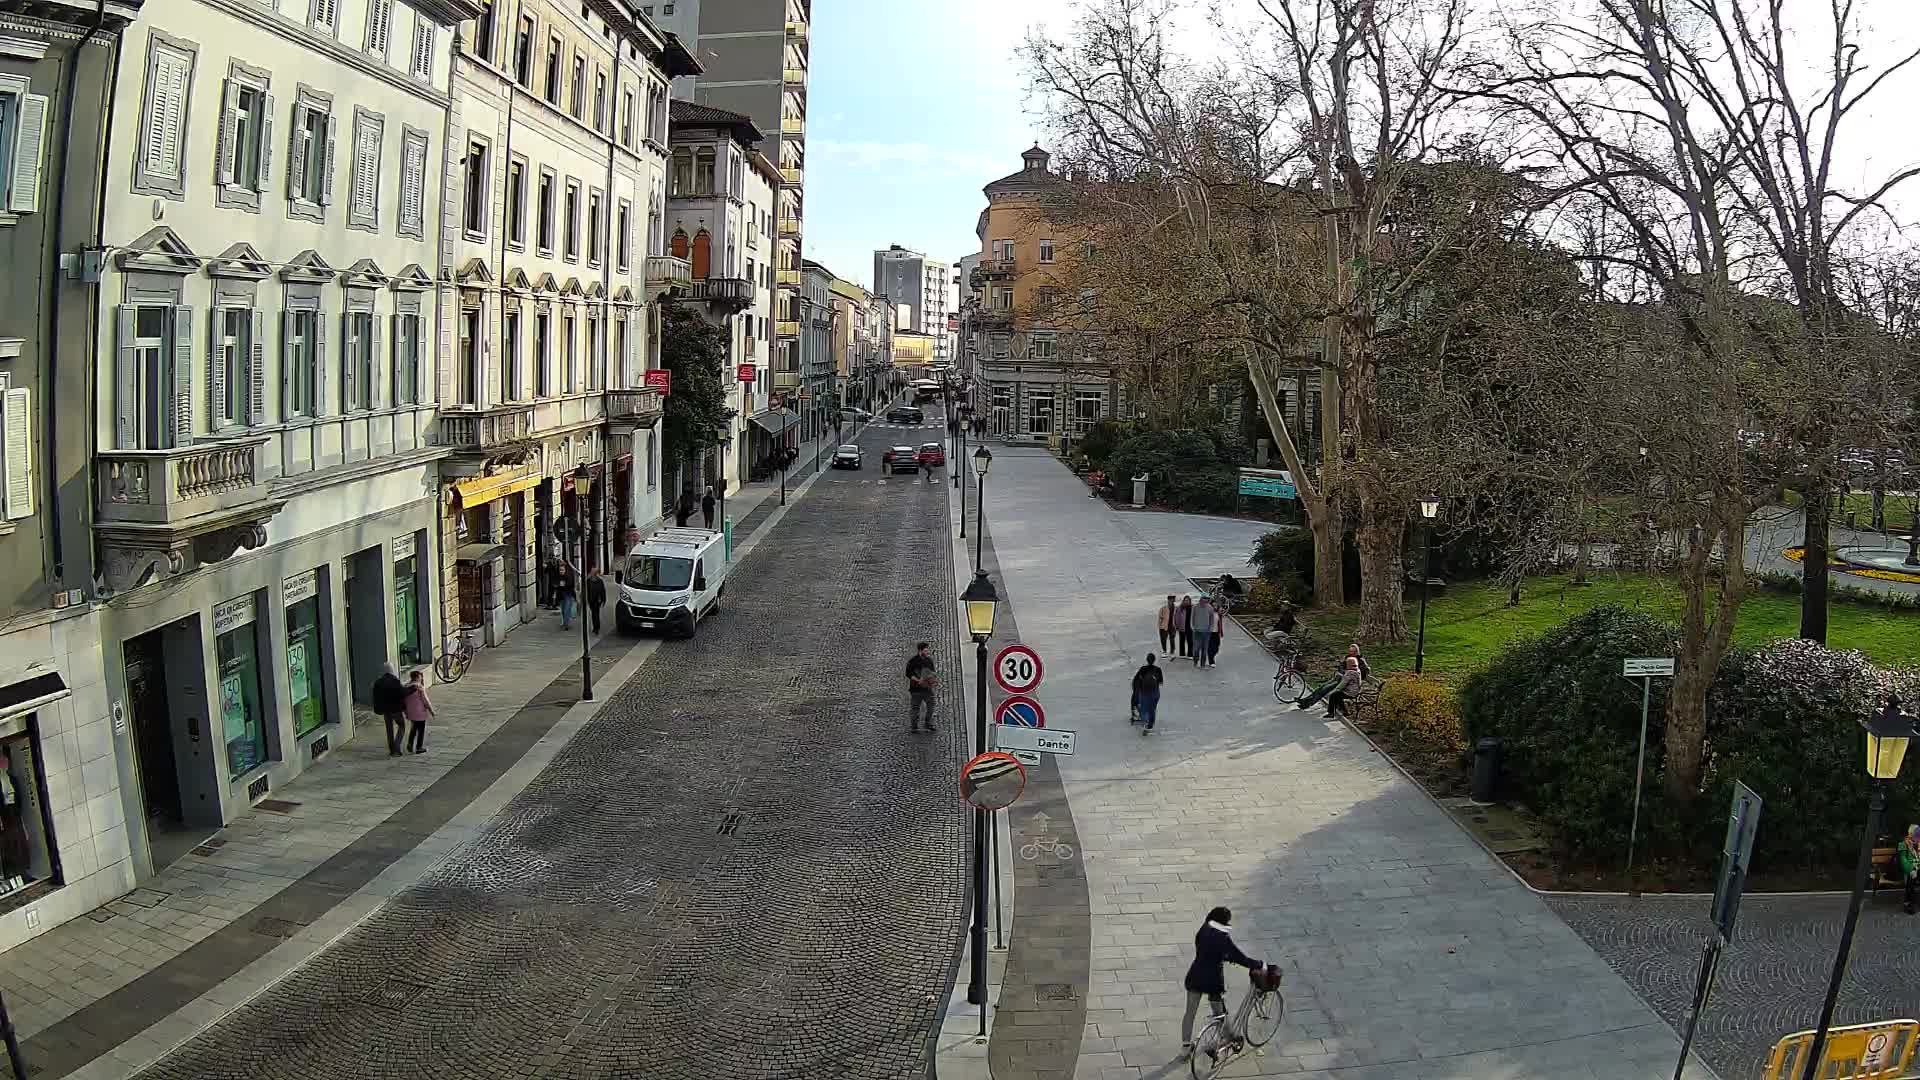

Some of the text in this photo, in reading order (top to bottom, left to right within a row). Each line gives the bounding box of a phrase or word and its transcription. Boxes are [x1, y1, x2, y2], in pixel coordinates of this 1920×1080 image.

[215, 612, 244, 629] OPERATIVO
[1004, 658, 1032, 681] 30
[1037, 738, 1070, 750] Dante
